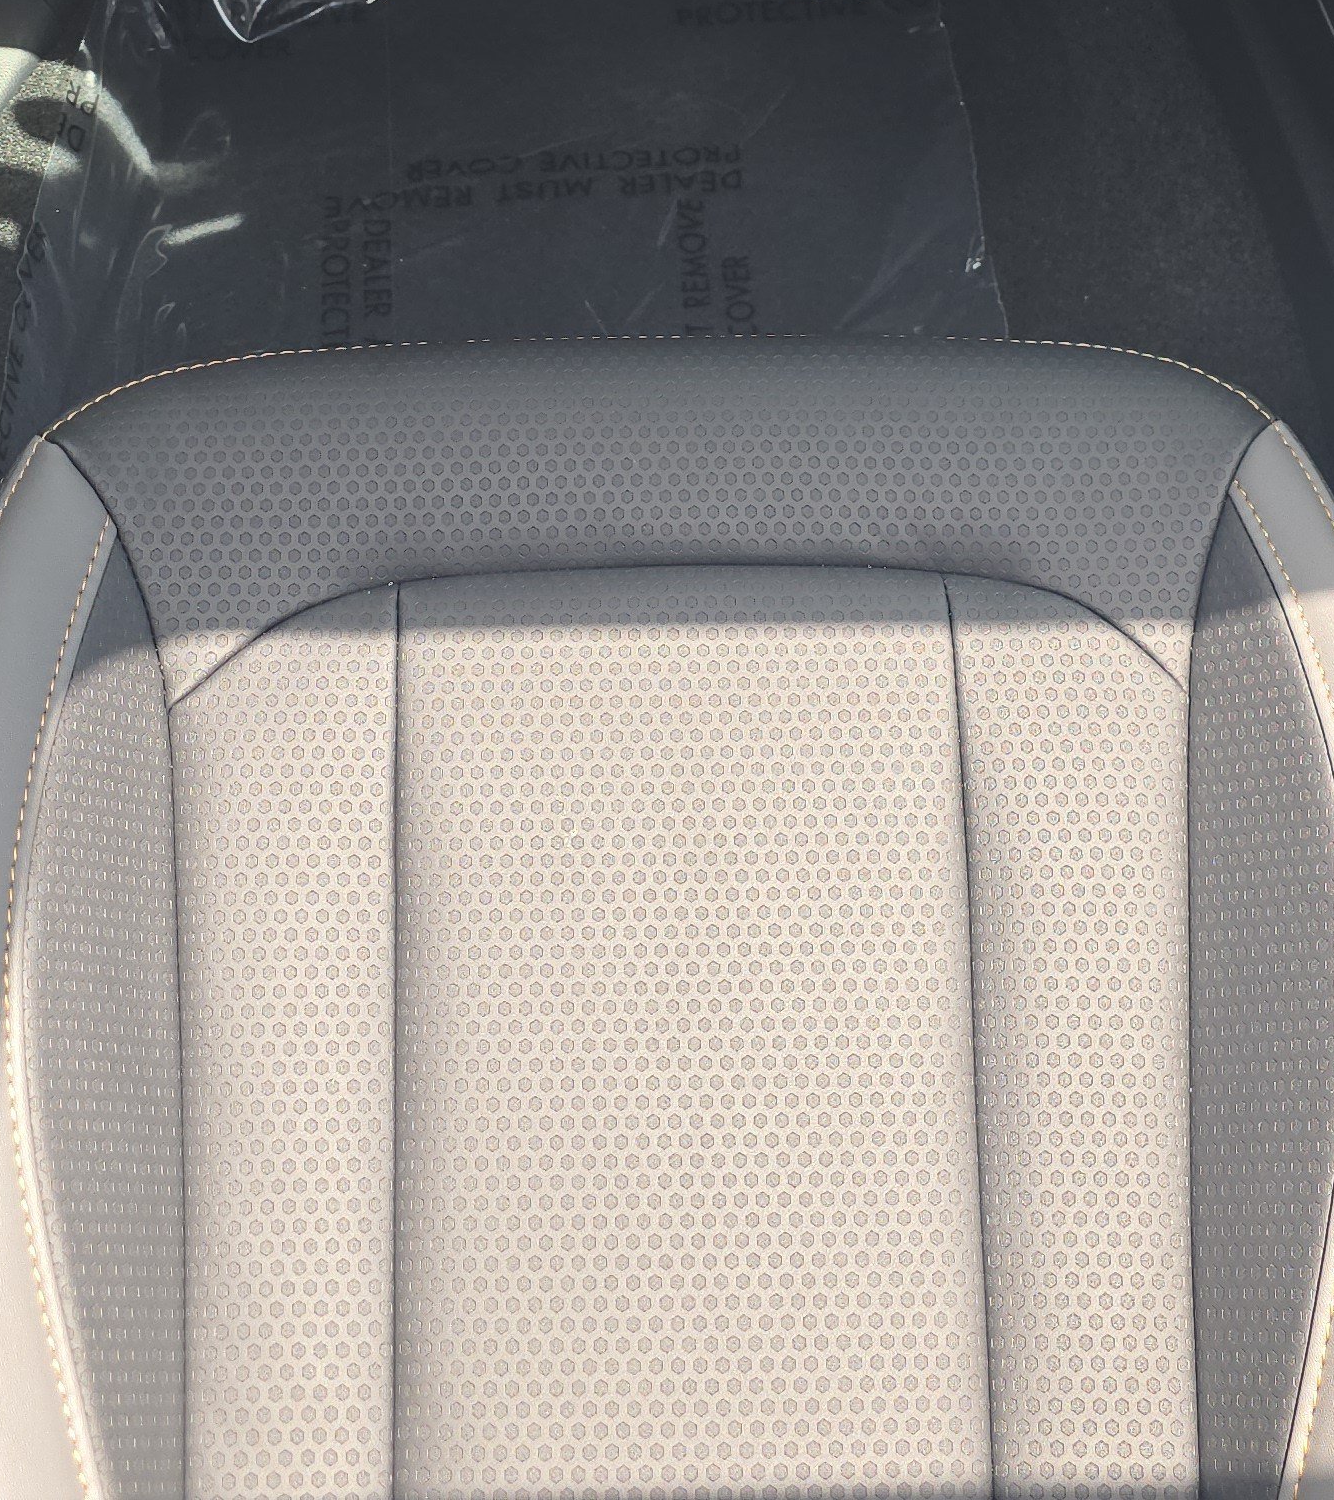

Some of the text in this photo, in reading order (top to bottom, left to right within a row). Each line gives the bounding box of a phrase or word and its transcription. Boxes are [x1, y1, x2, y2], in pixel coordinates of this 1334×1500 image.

[324, 168, 742, 218] DEALER MUST REMOVE
[407, 145, 742, 183] PROTECTIVE COVER
[364, 218, 393, 319] DEALER
[677, 198, 711, 309] REMOVE
[722, 255, 758, 336] COVER
